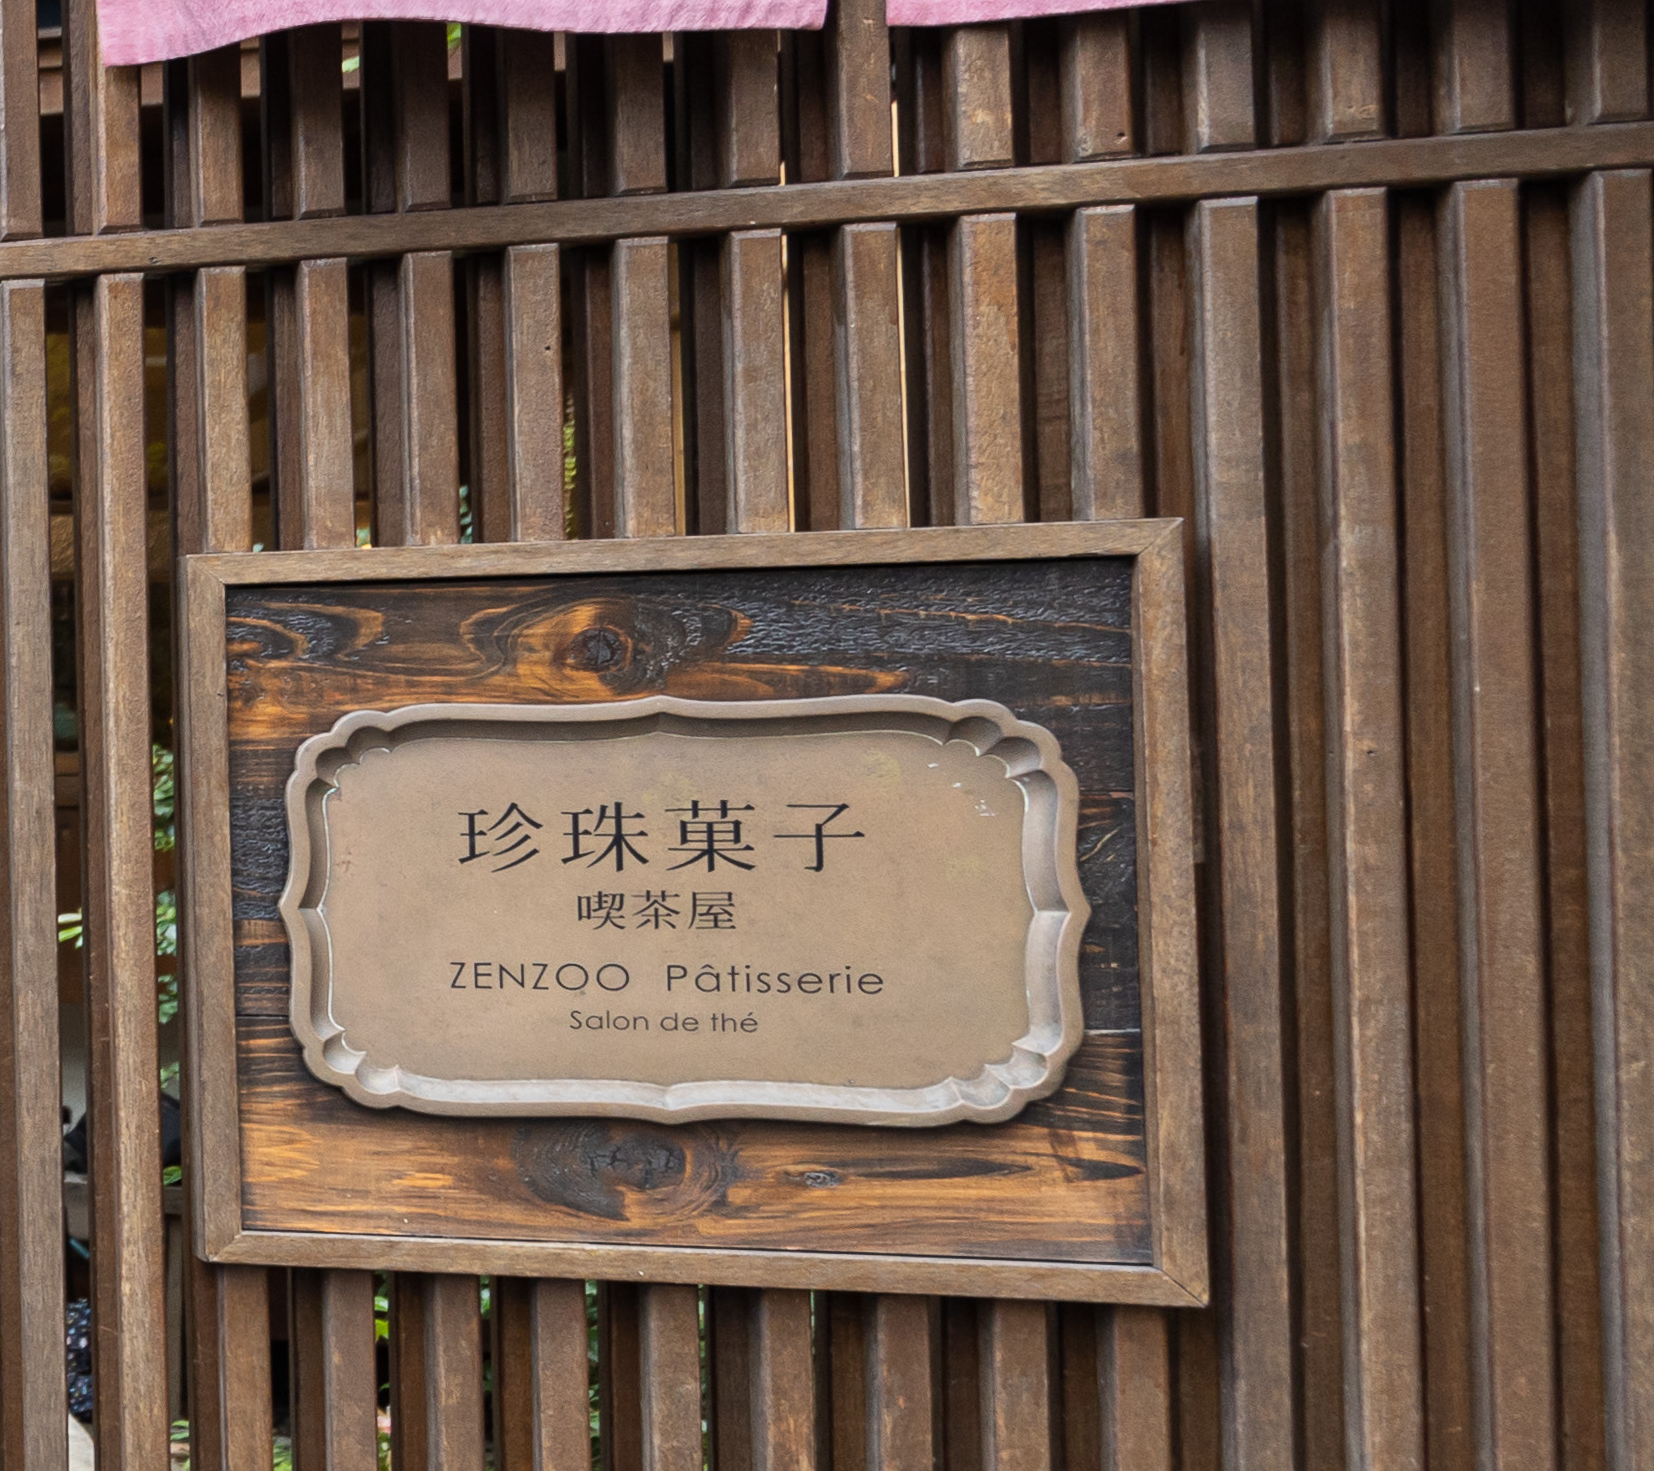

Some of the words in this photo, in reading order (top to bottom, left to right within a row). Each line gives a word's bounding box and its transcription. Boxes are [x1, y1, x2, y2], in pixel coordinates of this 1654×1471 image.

[457, 799, 866, 874] 珍珠菓子
[576, 889, 738, 931] 喫茶屋
[450, 961, 631, 993] ZENZOO
[666, 964, 886, 996] Pâtisserie
[569, 1010, 650, 1032] Salon
[660, 1011, 700, 1033] de
[710, 1010, 759, 1034] thé
